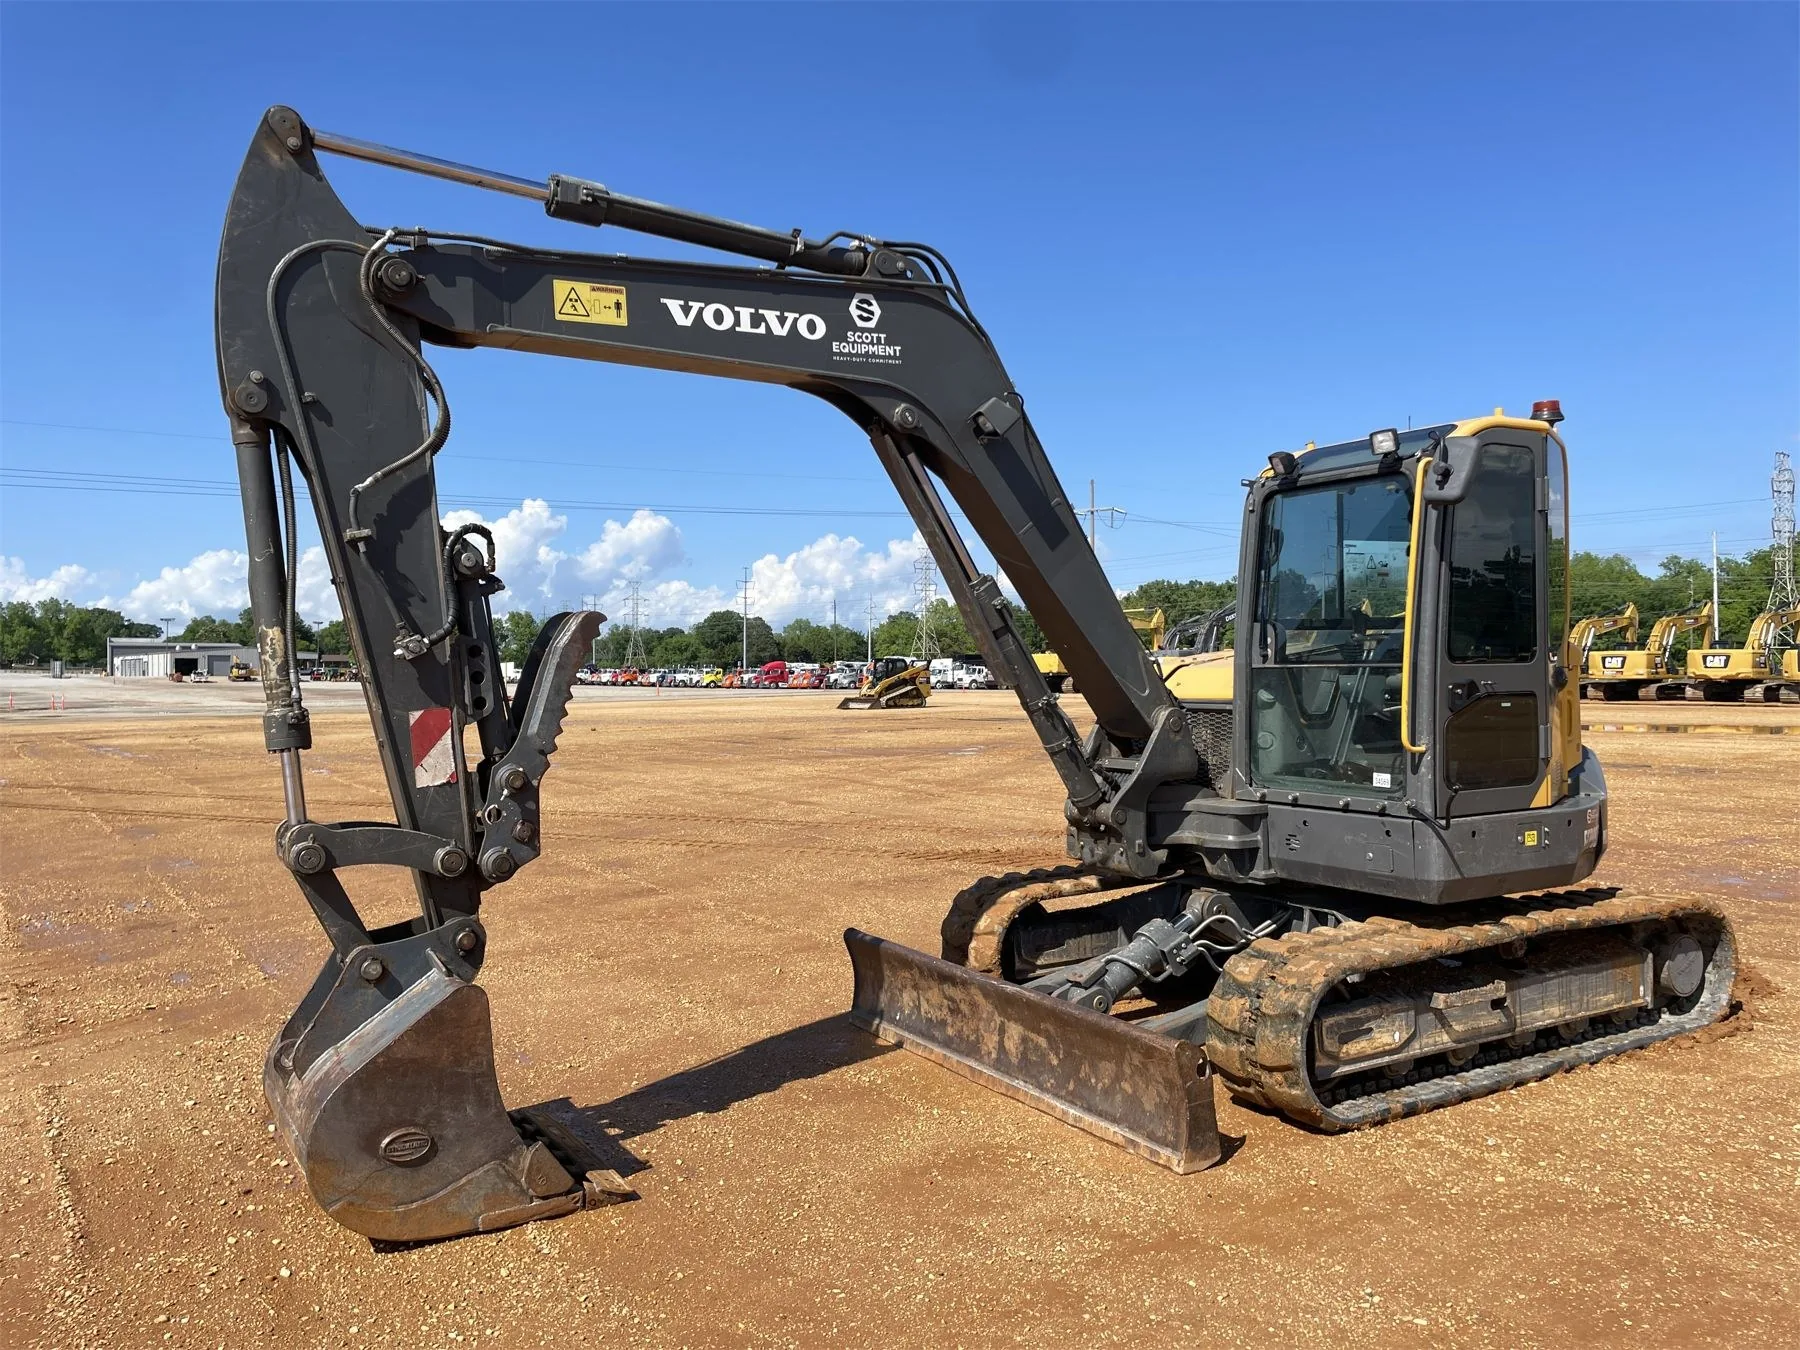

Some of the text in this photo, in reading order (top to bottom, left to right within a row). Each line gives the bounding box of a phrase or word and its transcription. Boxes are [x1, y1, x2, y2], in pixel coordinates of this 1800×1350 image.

[596, 286, 623, 294] WARNING
[660, 297, 827, 341] VOLVO
[846, 331, 887, 345] SCOTT
[832, 341, 901, 357] EQUIPMENT
[1604, 656, 1624, 668] CAT
[1706, 655, 1727, 668] CAT
